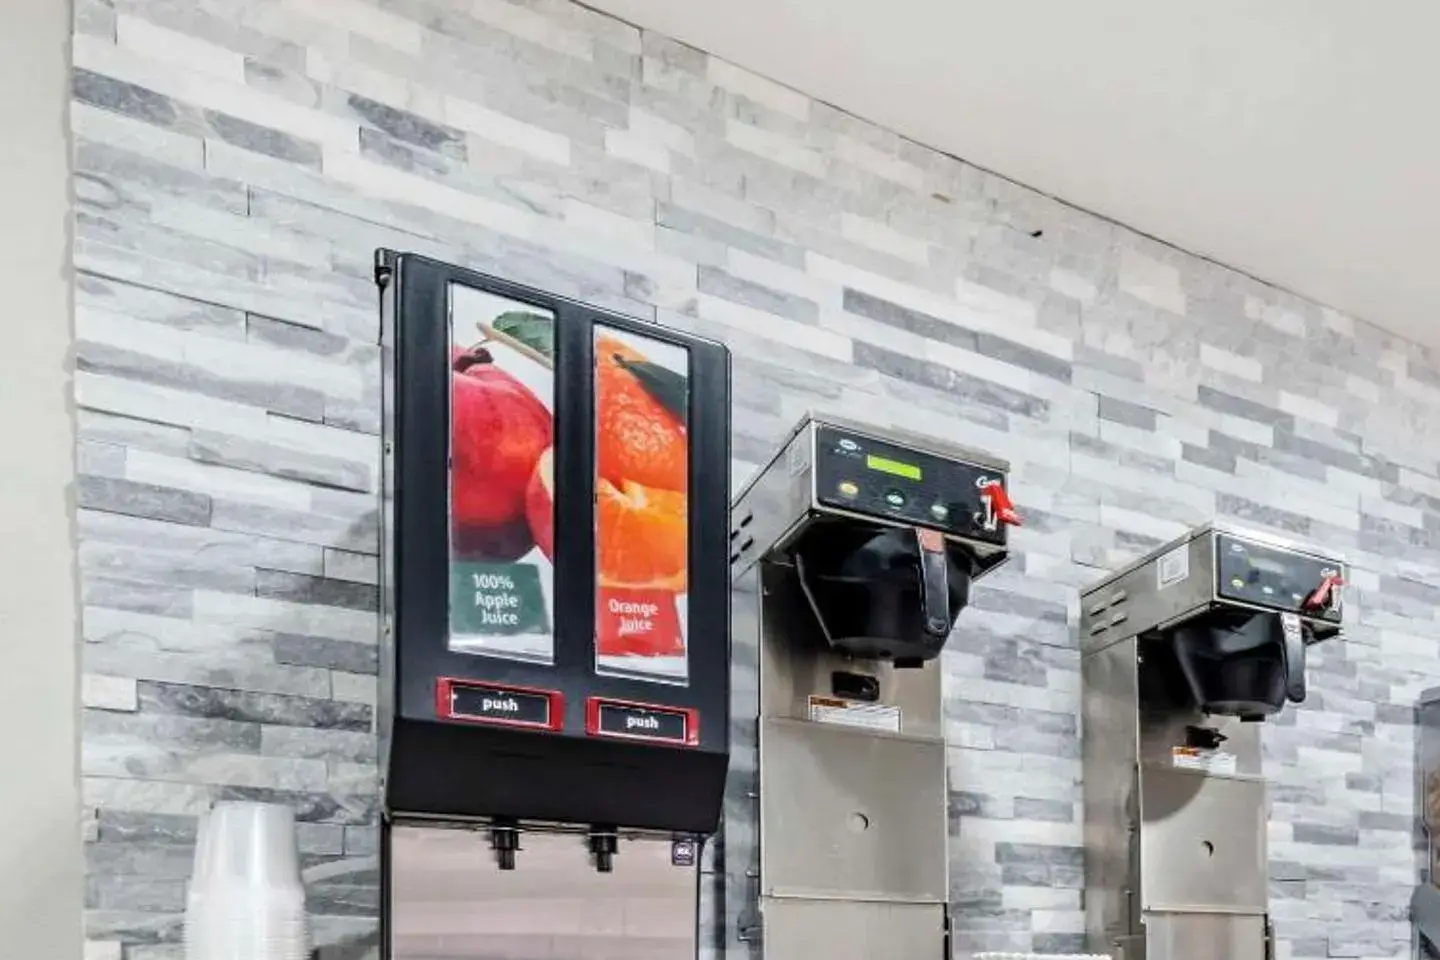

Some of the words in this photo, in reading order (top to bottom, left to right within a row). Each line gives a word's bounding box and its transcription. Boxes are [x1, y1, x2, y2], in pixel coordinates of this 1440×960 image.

[472, 572, 514, 590] 100%
[475, 591, 519, 609] Apple
[608, 598, 659, 616] Orange
[481, 610, 519, 626] Juice
[619, 616, 654, 632] Juice
[482, 697, 519, 712] push
[626, 715, 660, 729] push
